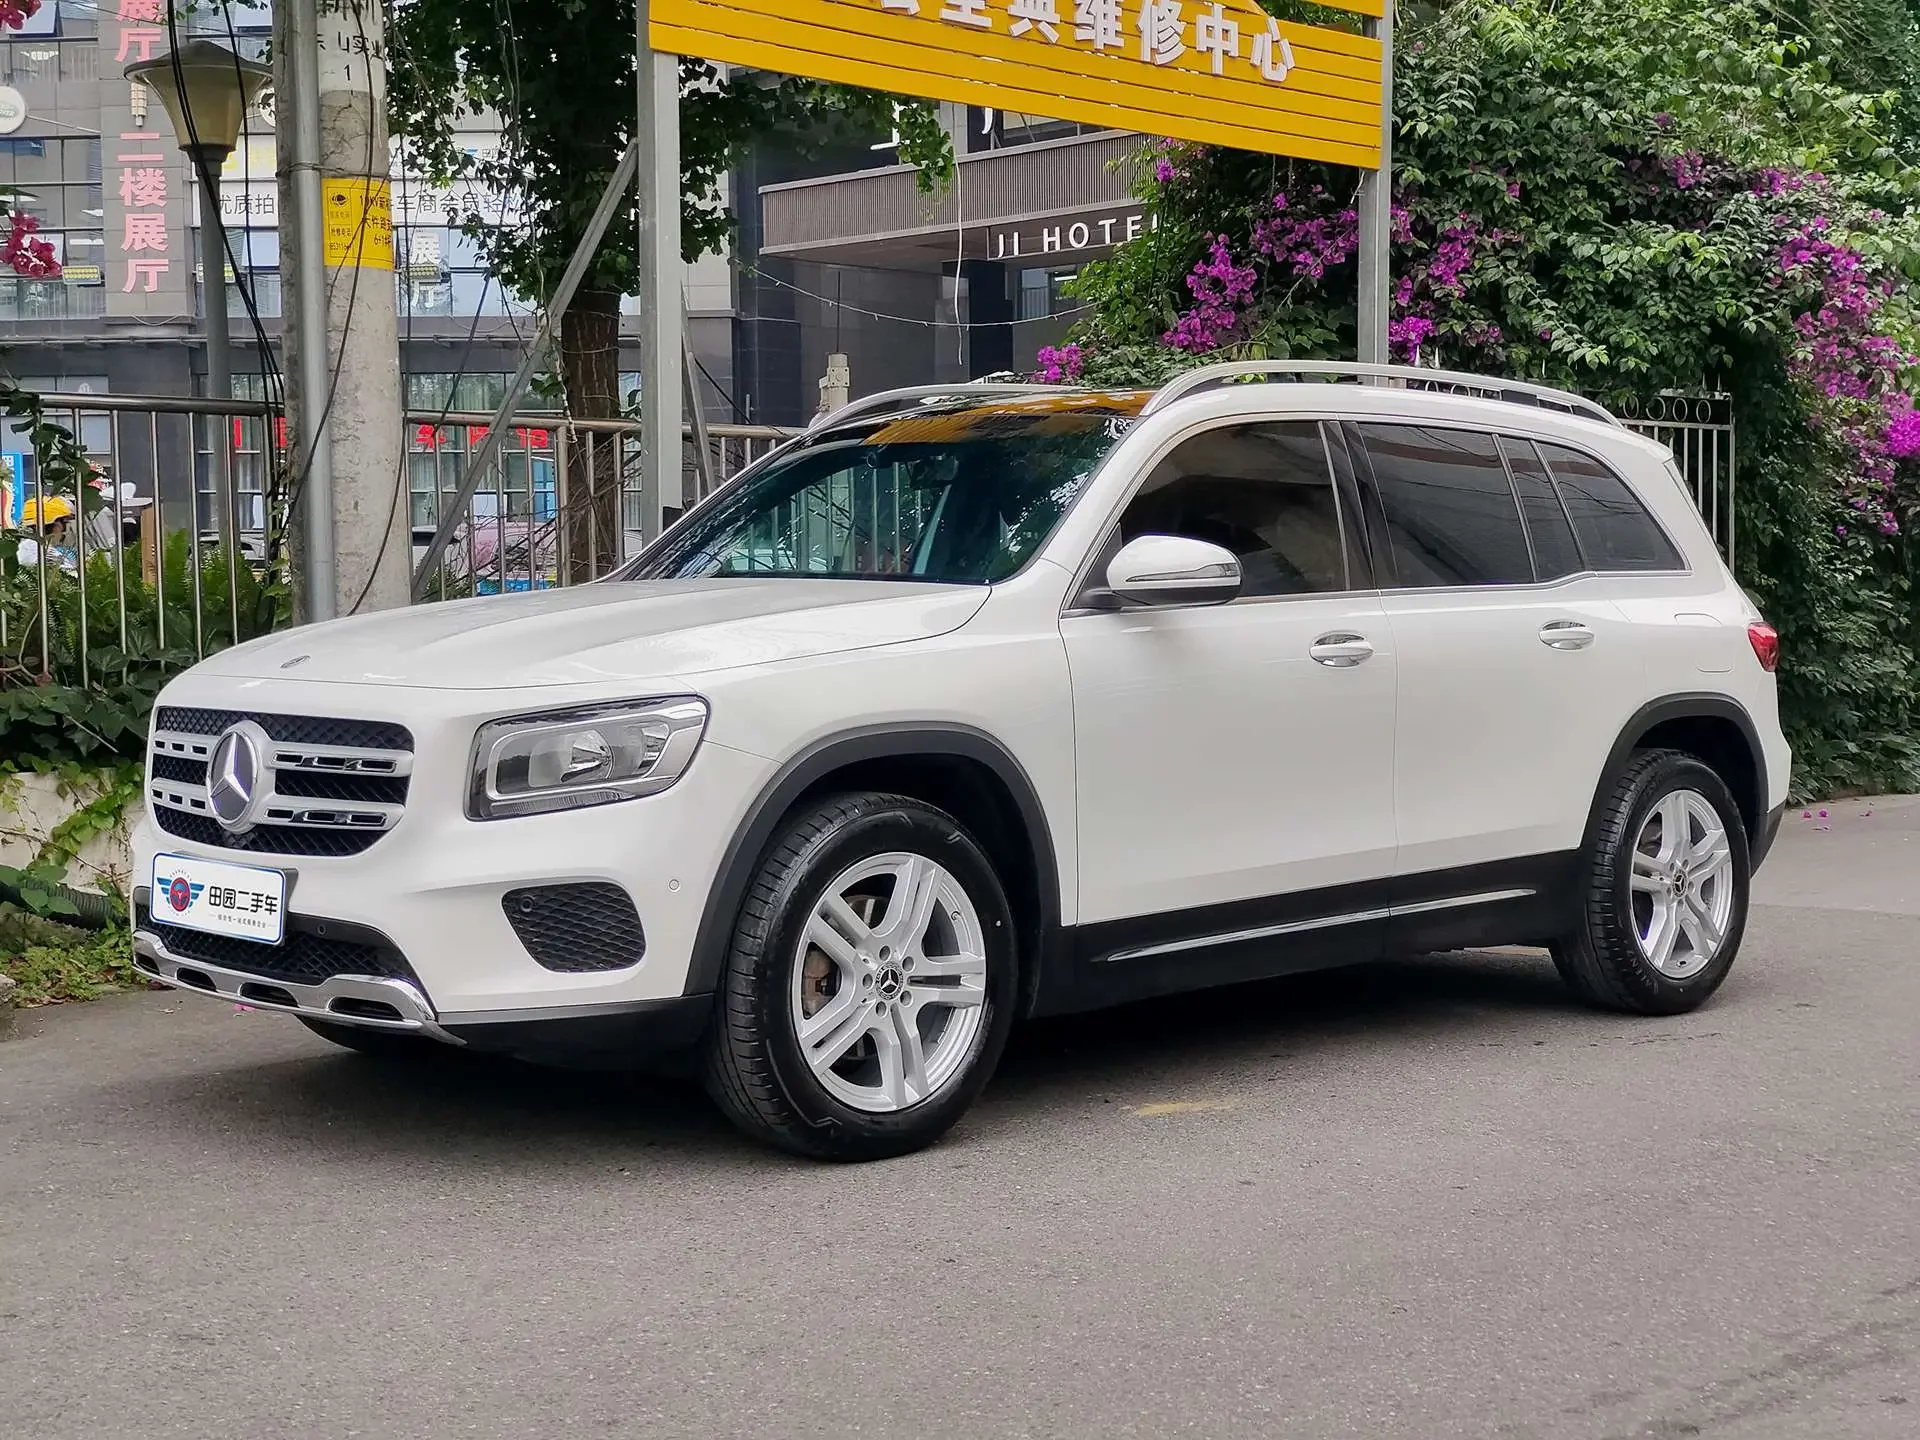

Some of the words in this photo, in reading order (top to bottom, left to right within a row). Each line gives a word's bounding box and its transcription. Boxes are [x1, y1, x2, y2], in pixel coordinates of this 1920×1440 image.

[117, 132, 169, 293] 二楼展厅
[997, 231, 1019, 258] JI
[208, 885, 278, 915] 田园二手车
